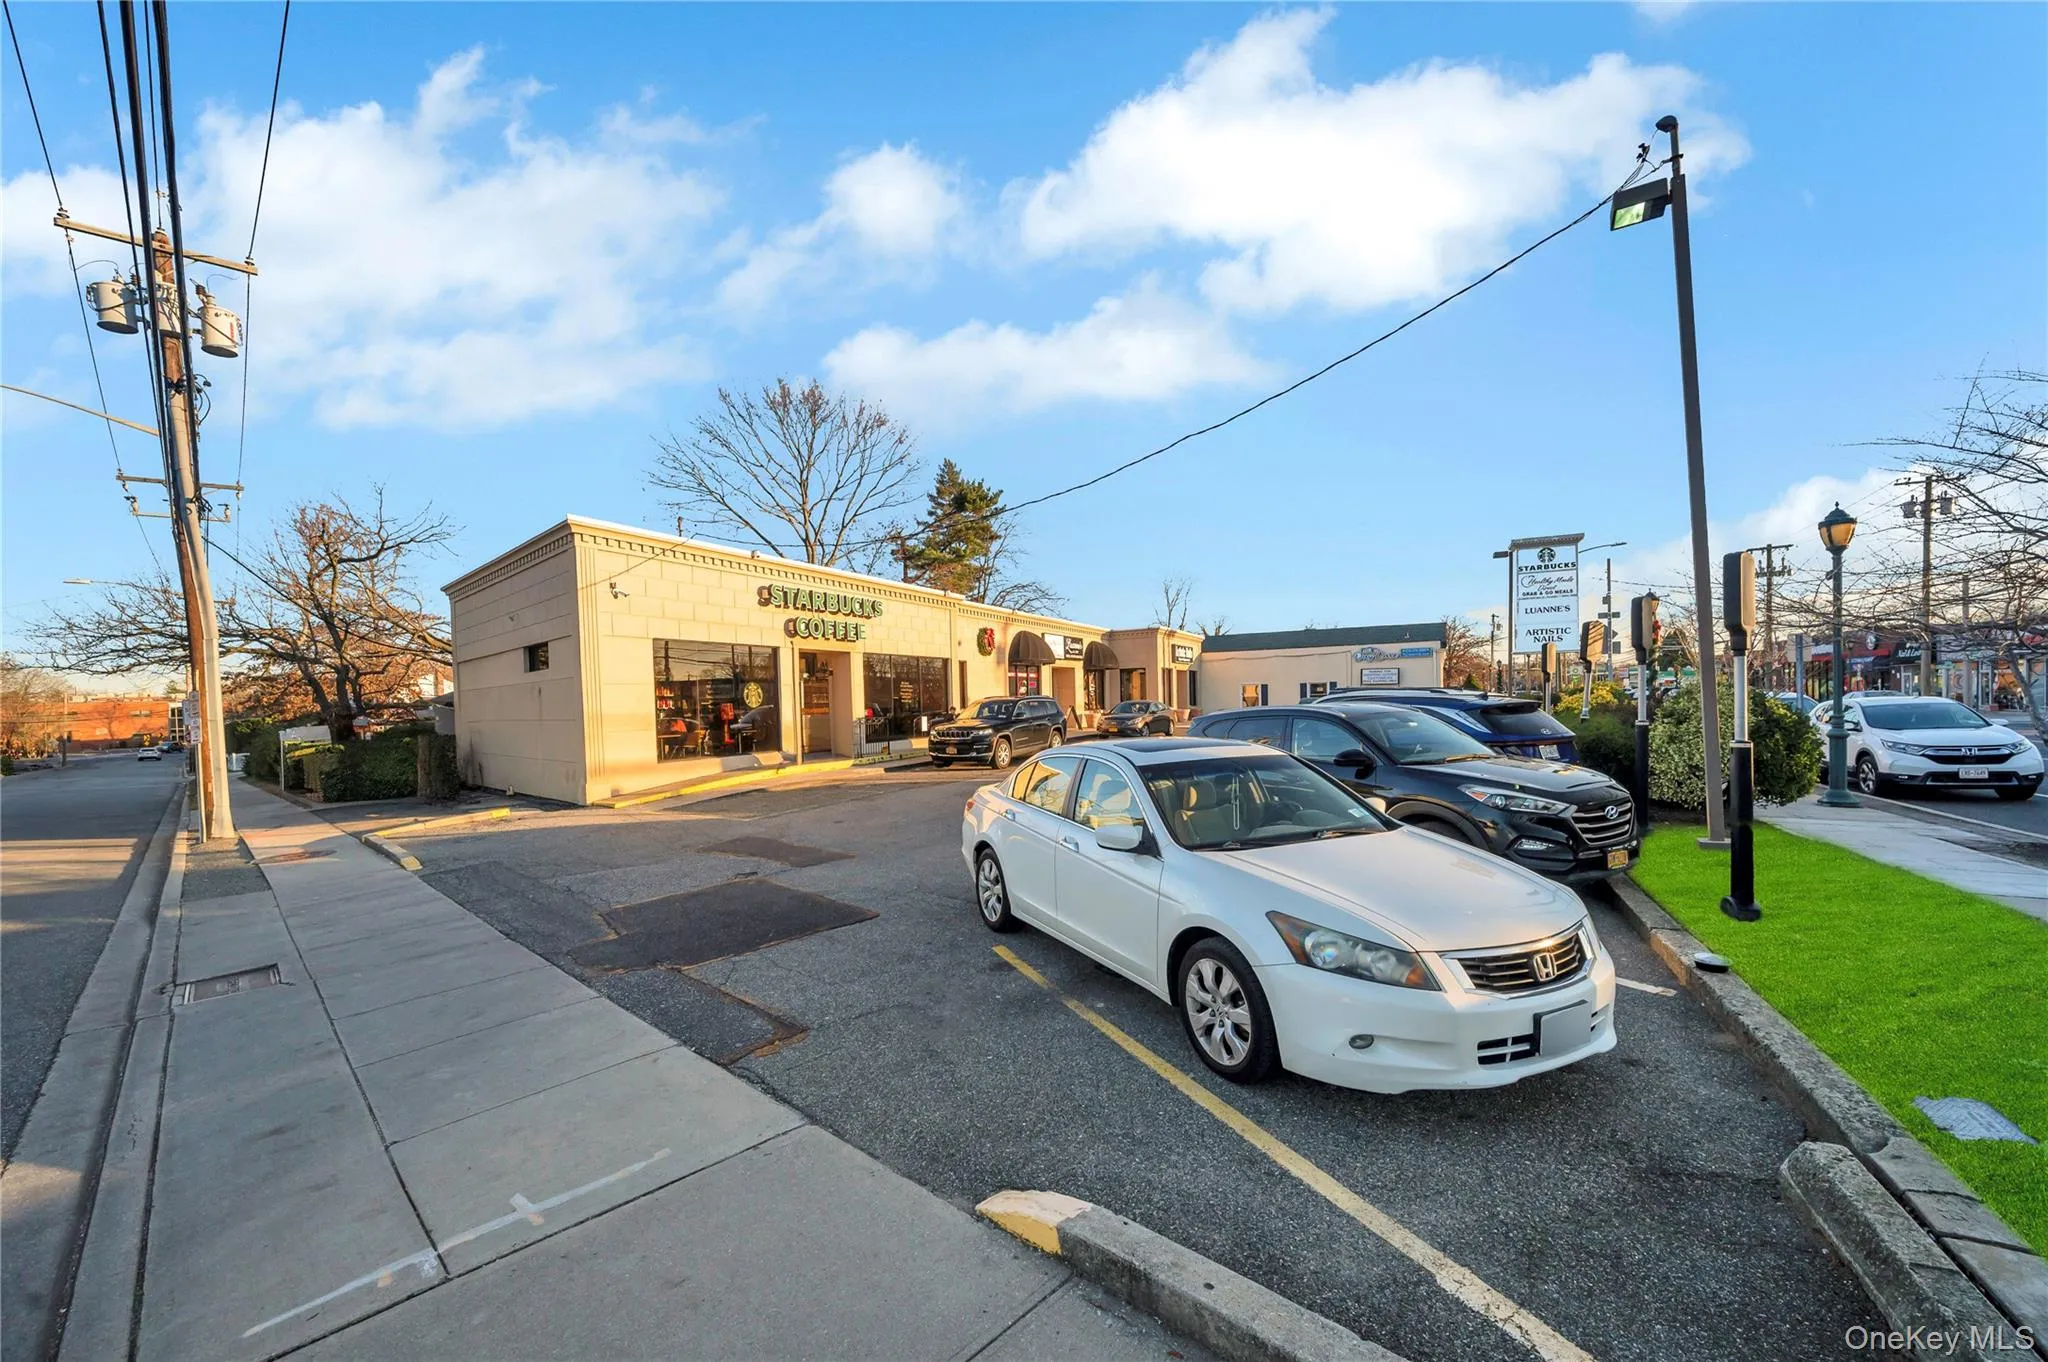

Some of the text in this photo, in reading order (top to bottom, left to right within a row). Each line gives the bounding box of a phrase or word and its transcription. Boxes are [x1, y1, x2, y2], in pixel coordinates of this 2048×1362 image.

[1518, 562, 1576, 571] STARBUCKS
[769, 584, 883, 617] STARBUCKS
[1525, 605, 1571, 615] LUANNE'S
[796, 617, 866, 641] COFFEE
[1525, 627, 1572, 637] ARTISTIC
[1533, 635, 1564, 644] NAILS
